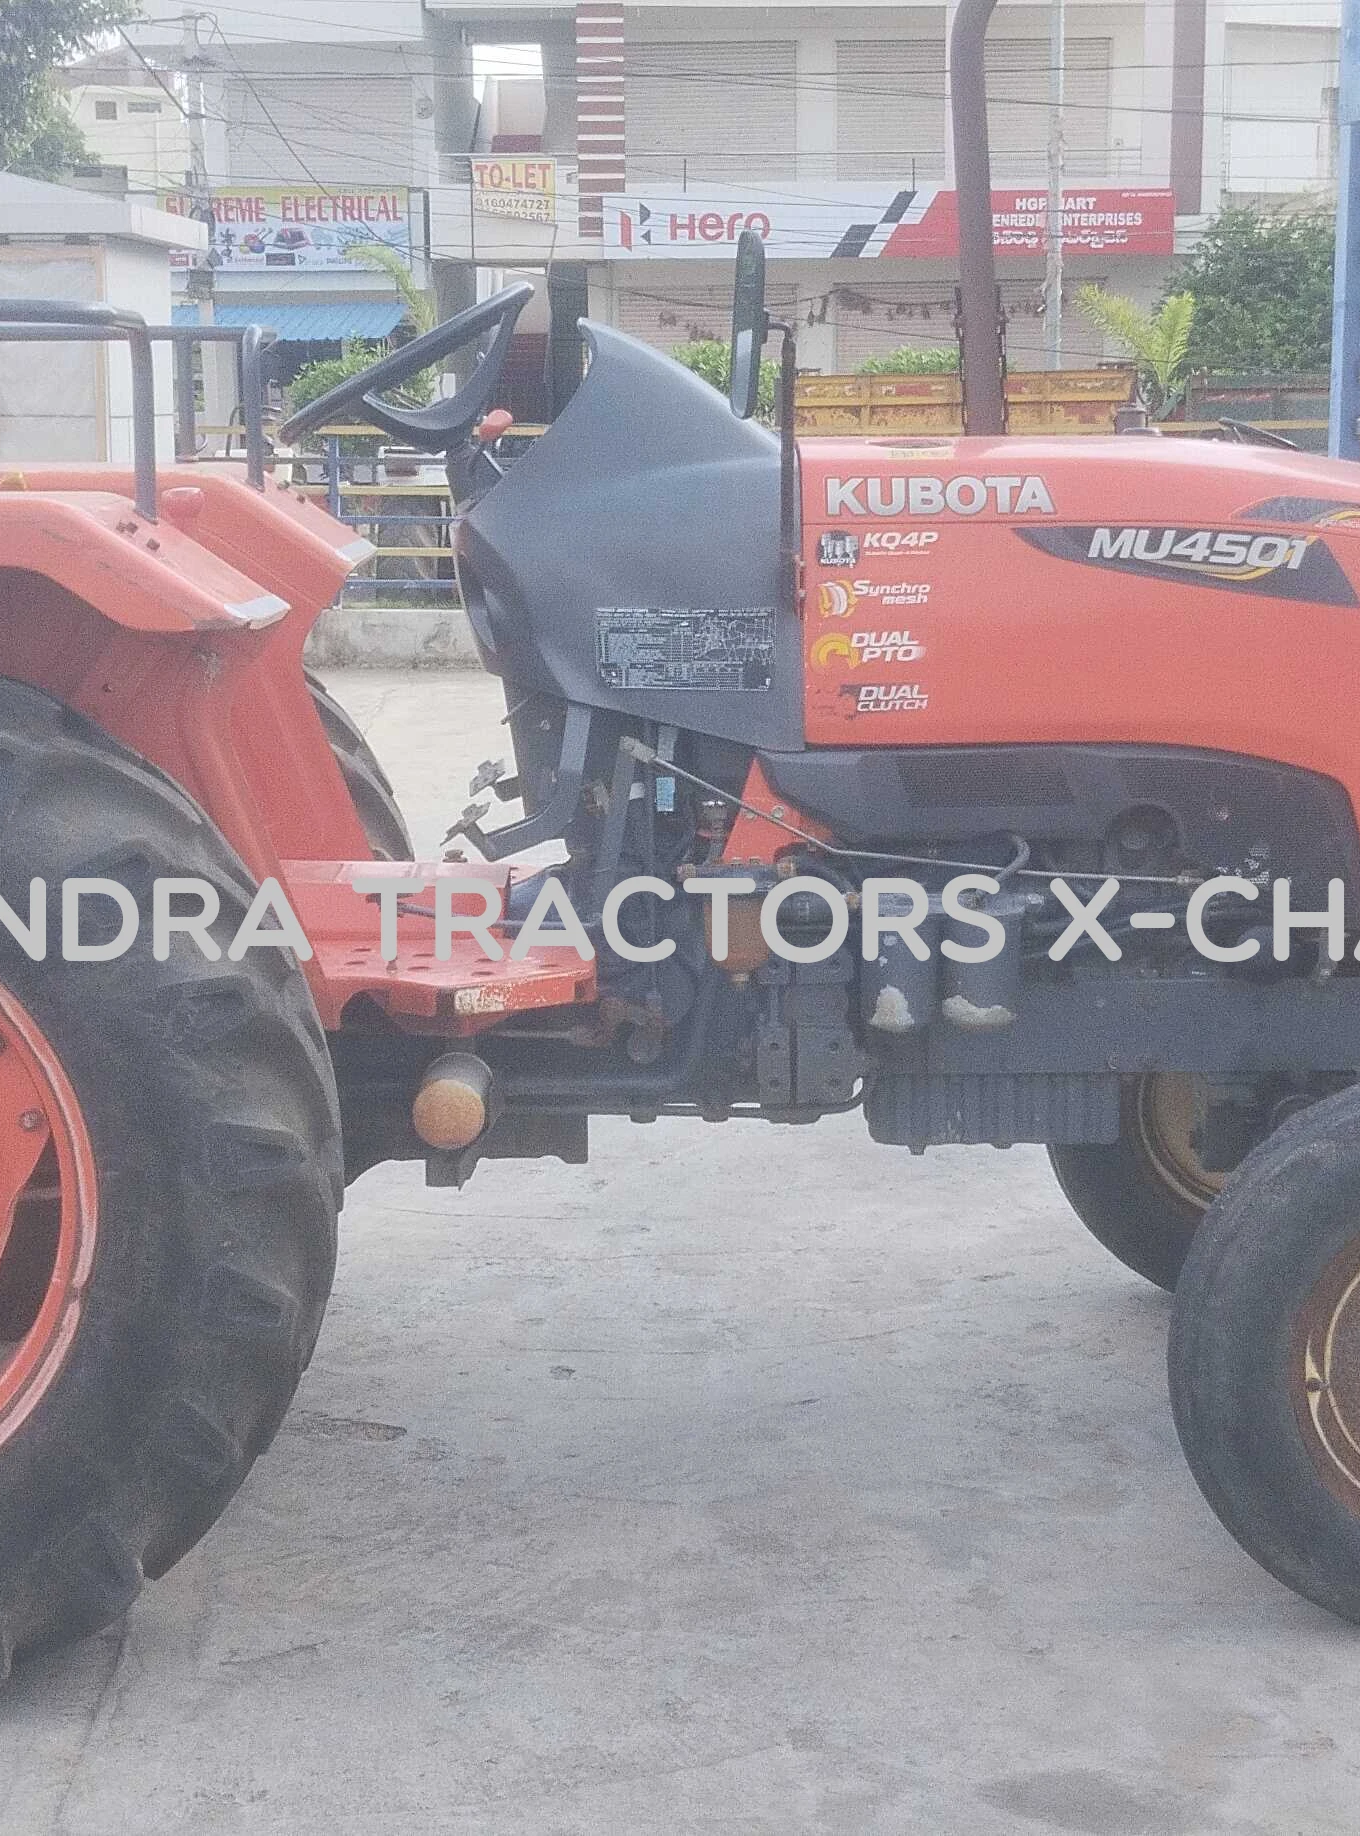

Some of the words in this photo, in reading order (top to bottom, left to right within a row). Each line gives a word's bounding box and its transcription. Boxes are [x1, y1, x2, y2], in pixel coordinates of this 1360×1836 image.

[473, 163, 552, 189] TO-LET
[280, 194, 403, 223] ELECTRICAL
[669, 212, 771, 241] Hero
[825, 474, 1058, 517] KUBOTA
[863, 531, 939, 550] KQ4P
[1088, 527, 1308, 570] MU4501
[851, 579, 931, 598] Synchro
[881, 592, 929, 605] mesh
[850, 630, 920, 648] DUAL
[861, 646, 923, 663] PTO
[857, 685, 930, 701] DUAL
[856, 699, 929, 712] CLUTCH
